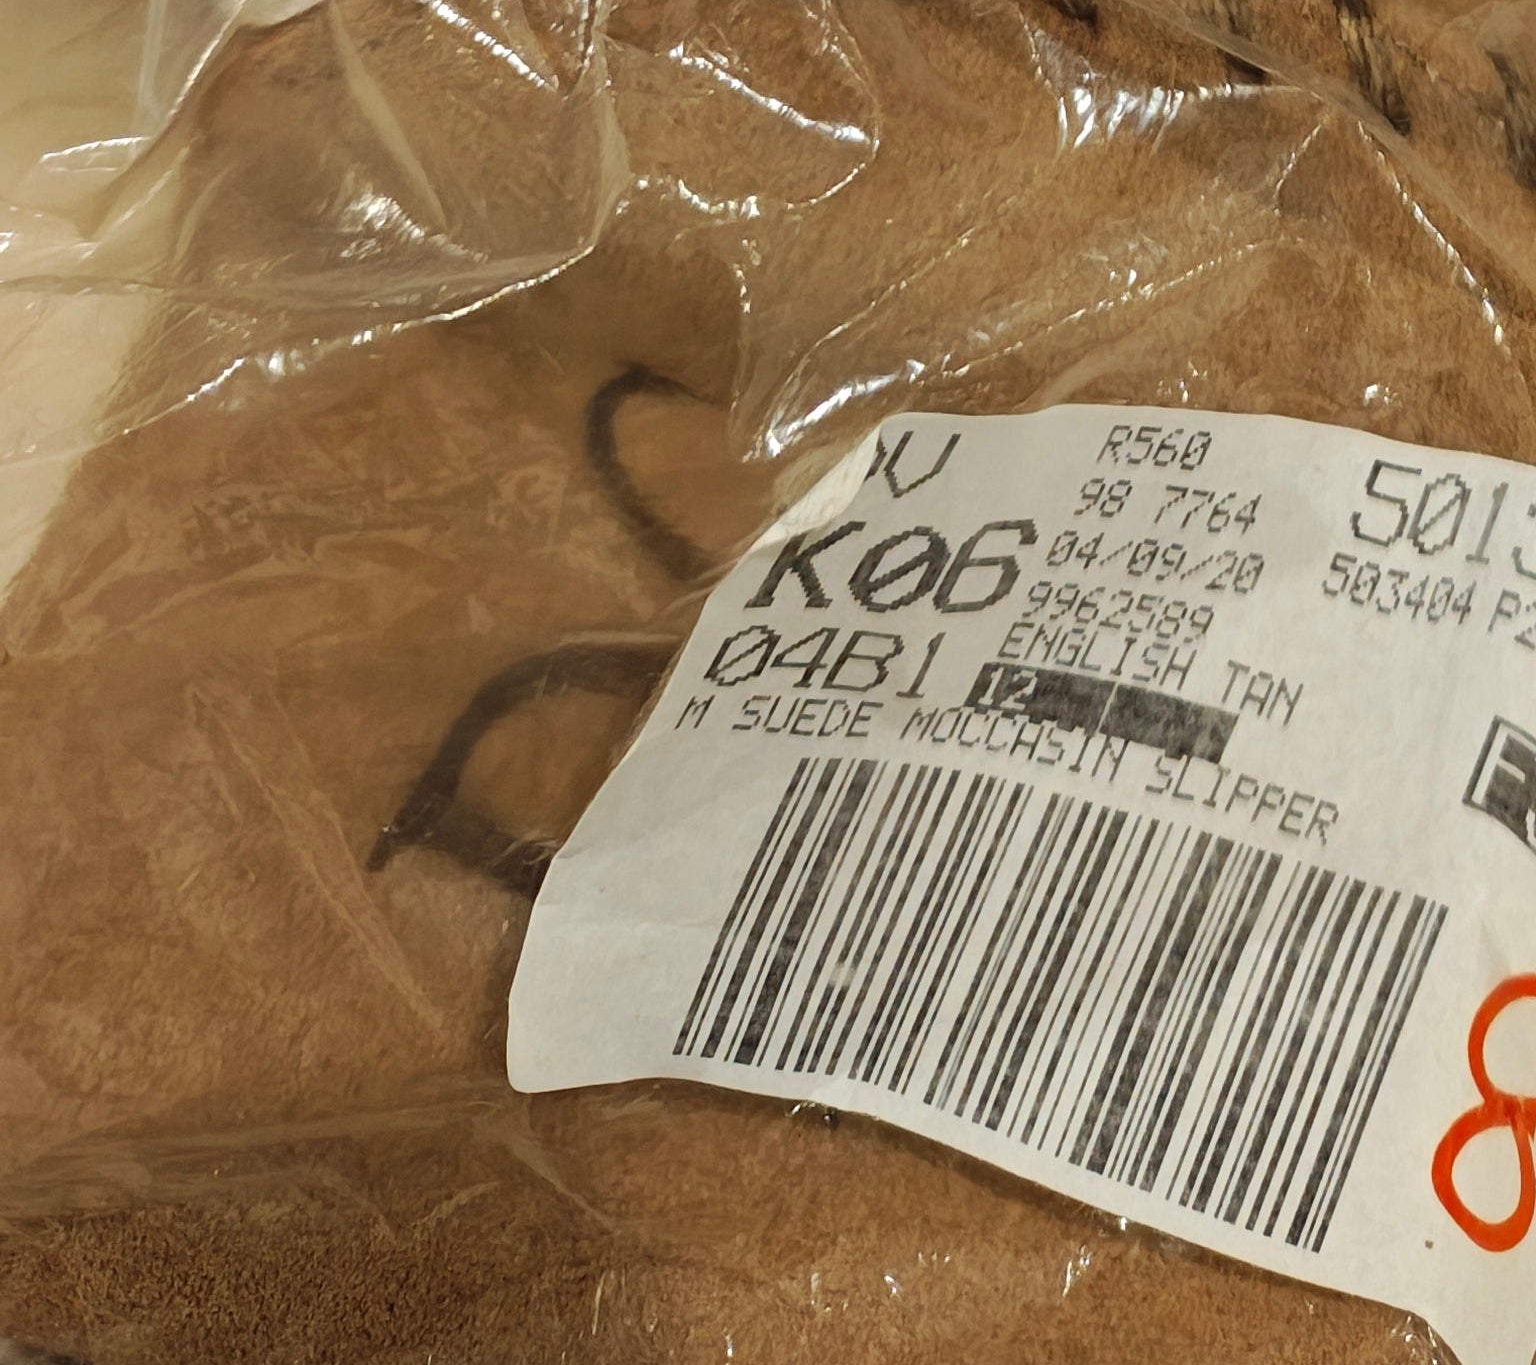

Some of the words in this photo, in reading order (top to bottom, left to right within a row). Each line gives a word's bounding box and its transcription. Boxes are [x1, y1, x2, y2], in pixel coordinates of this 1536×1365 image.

[1096, 424, 1212, 471] R560
[1072, 477, 1133, 518] 98
[1153, 484, 1262, 536] 7764
[743, 518, 1039, 614] K06
[1046, 529, 1265, 594] 04/09/20
[1321, 551, 1478, 625] 503404
[1021, 580, 1215, 644] 9962589
[703, 624, 947, 699] 04B1
[997, 621, 1198, 691] ENGLISH
[1222, 659, 1304, 726] TAN
[674, 694, 716, 731] M
[731, 694, 884, 739] SUEDE
[898, 706, 1130, 783] MOCCASIN
[1144, 754, 1340, 847] SLIPPER
